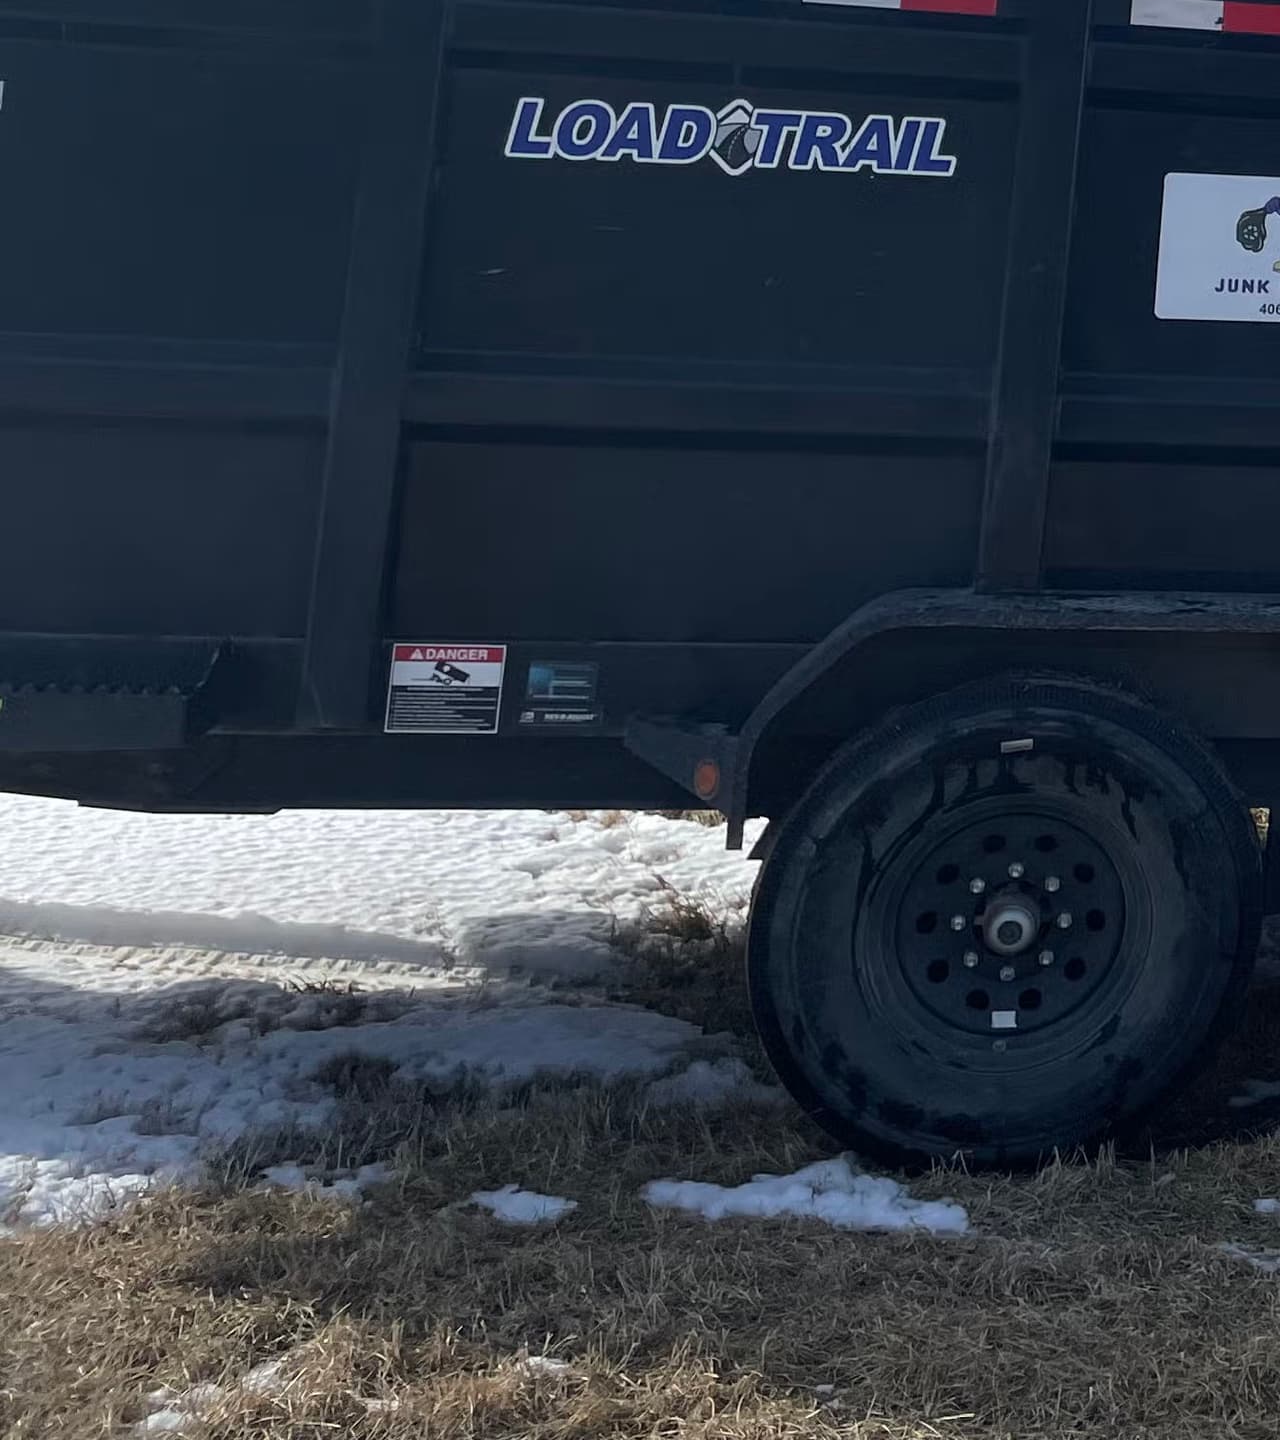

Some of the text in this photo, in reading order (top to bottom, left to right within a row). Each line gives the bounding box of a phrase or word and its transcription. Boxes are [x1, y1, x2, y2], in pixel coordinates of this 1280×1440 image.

[504, 97, 957, 177] LOAD TRAIL
[1214, 277, 1270, 294] JUNK
[425, 648, 489, 661] DANGER
